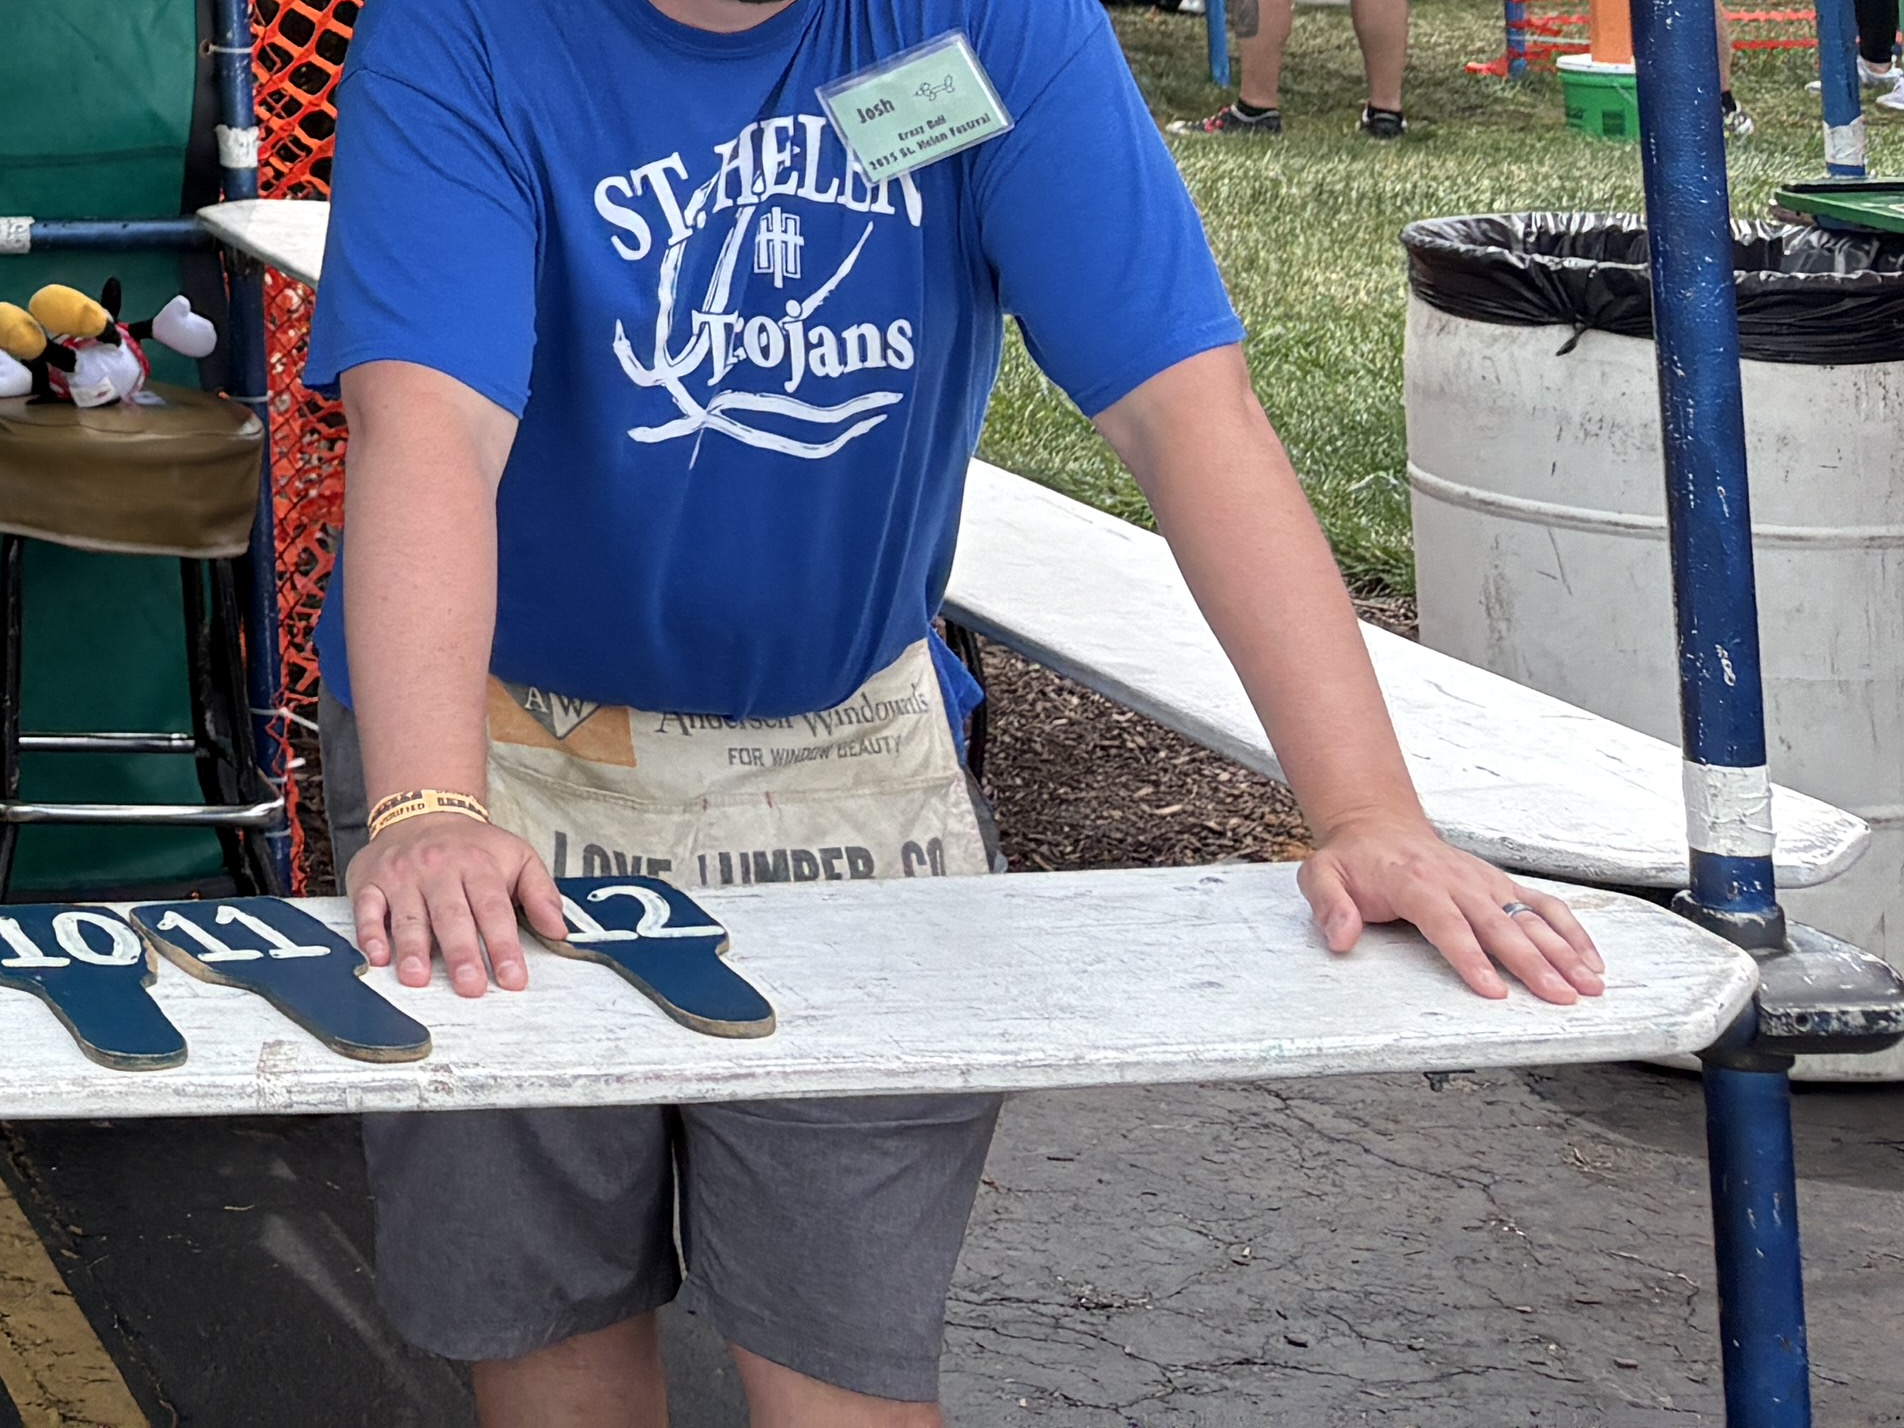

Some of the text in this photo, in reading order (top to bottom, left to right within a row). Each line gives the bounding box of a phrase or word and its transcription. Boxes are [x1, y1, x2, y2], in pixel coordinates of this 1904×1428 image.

[856, 98, 895, 124] Josh
[594, 151, 707, 261] ST.
[692, 299, 914, 392] Trojans
[728, 735, 902, 767] FOR WINDOW BEAUTY
[156, 905, 332, 963] 11
[561, 885, 725, 943] 12
